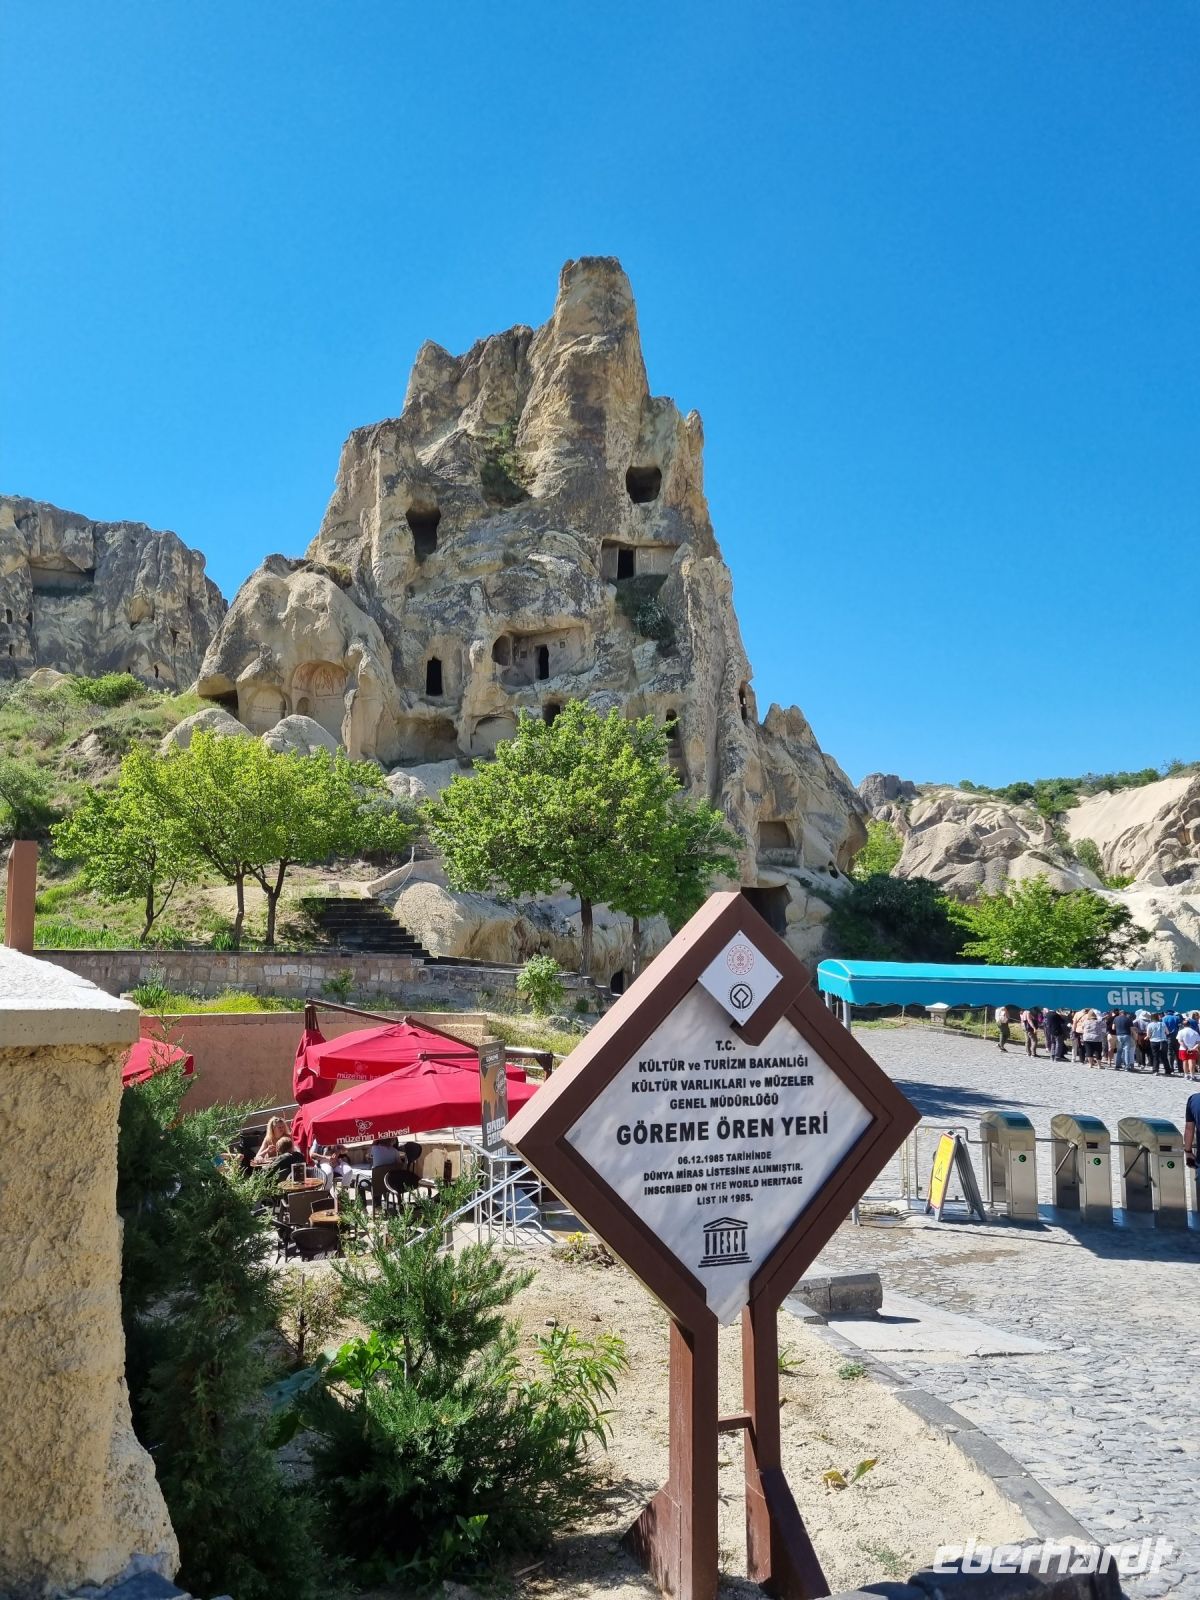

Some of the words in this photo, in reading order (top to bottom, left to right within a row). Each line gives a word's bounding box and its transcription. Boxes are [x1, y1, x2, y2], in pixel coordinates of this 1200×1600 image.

[1107, 987, 1165, 1010] GİRİŞ
[715, 1040, 736, 1051] T.C.
[638, 1058, 685, 1072] KÜLTÜR
[688, 1062, 701, 1071] ve
[704, 1056, 746, 1070] TURİZM
[749, 1054, 808, 1069] BAKANLIĞI
[631, 1079, 677, 1093] KÜLTÜR
[681, 1078, 746, 1091] VARLIKLARI
[749, 1080, 762, 1088] ve
[764, 1074, 814, 1088] MÜZELER
[669, 1098, 707, 1110] GENEL
[709, 1092, 779, 1108] MÜDÜRLÜĞÜ
[377, 1126, 410, 1139] kahvesi
[616, 1119, 709, 1146] GÖREME
[716, 1116, 774, 1140] ÖREN
[781, 1111, 828, 1136] YERİ
[677, 1153, 724, 1165] 06.12.1985
[726, 1150, 772, 1161] TARİHİNDE
[643, 1170, 674, 1182] DÜNYA
[676, 1168, 704, 1179] MİRAS
[706, 1165, 750, 1177] LİSTESİNE
[752, 1162, 804, 1174] ALINMIŞTIR.
[643, 1183, 693, 1195] INSCRIBED
[695, 1182, 708, 1191] ON
[710, 1181, 727, 1190] THE
[729, 1179, 759, 1189] WORLD
[761, 1176, 803, 1187] HERITAGE
[697, 1196, 716, 1205] LIST
[704, 1229, 746, 1256] UNESCO
